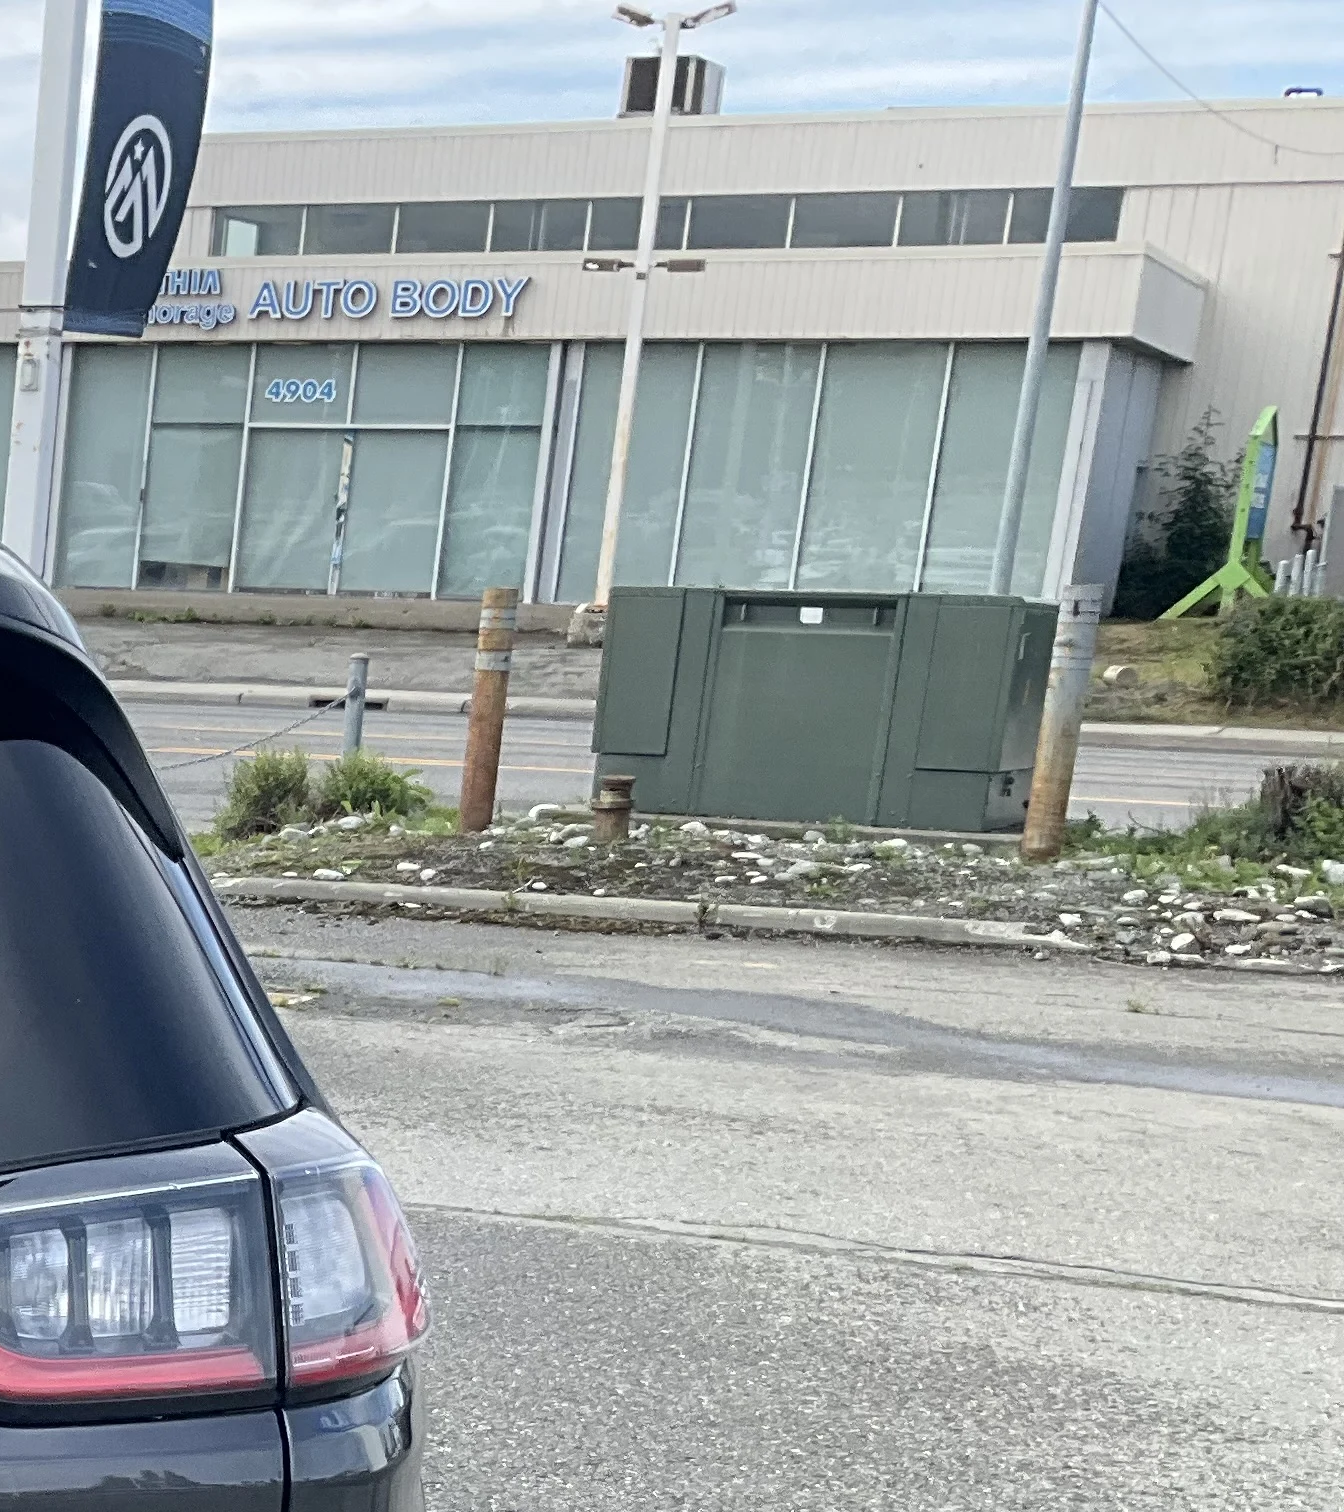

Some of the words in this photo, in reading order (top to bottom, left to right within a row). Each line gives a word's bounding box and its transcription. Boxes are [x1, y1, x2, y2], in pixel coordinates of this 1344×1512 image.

[248, 279, 378, 320] AUTO
[389, 275, 531, 319] BODY
[265, 378, 336, 403] 4904
